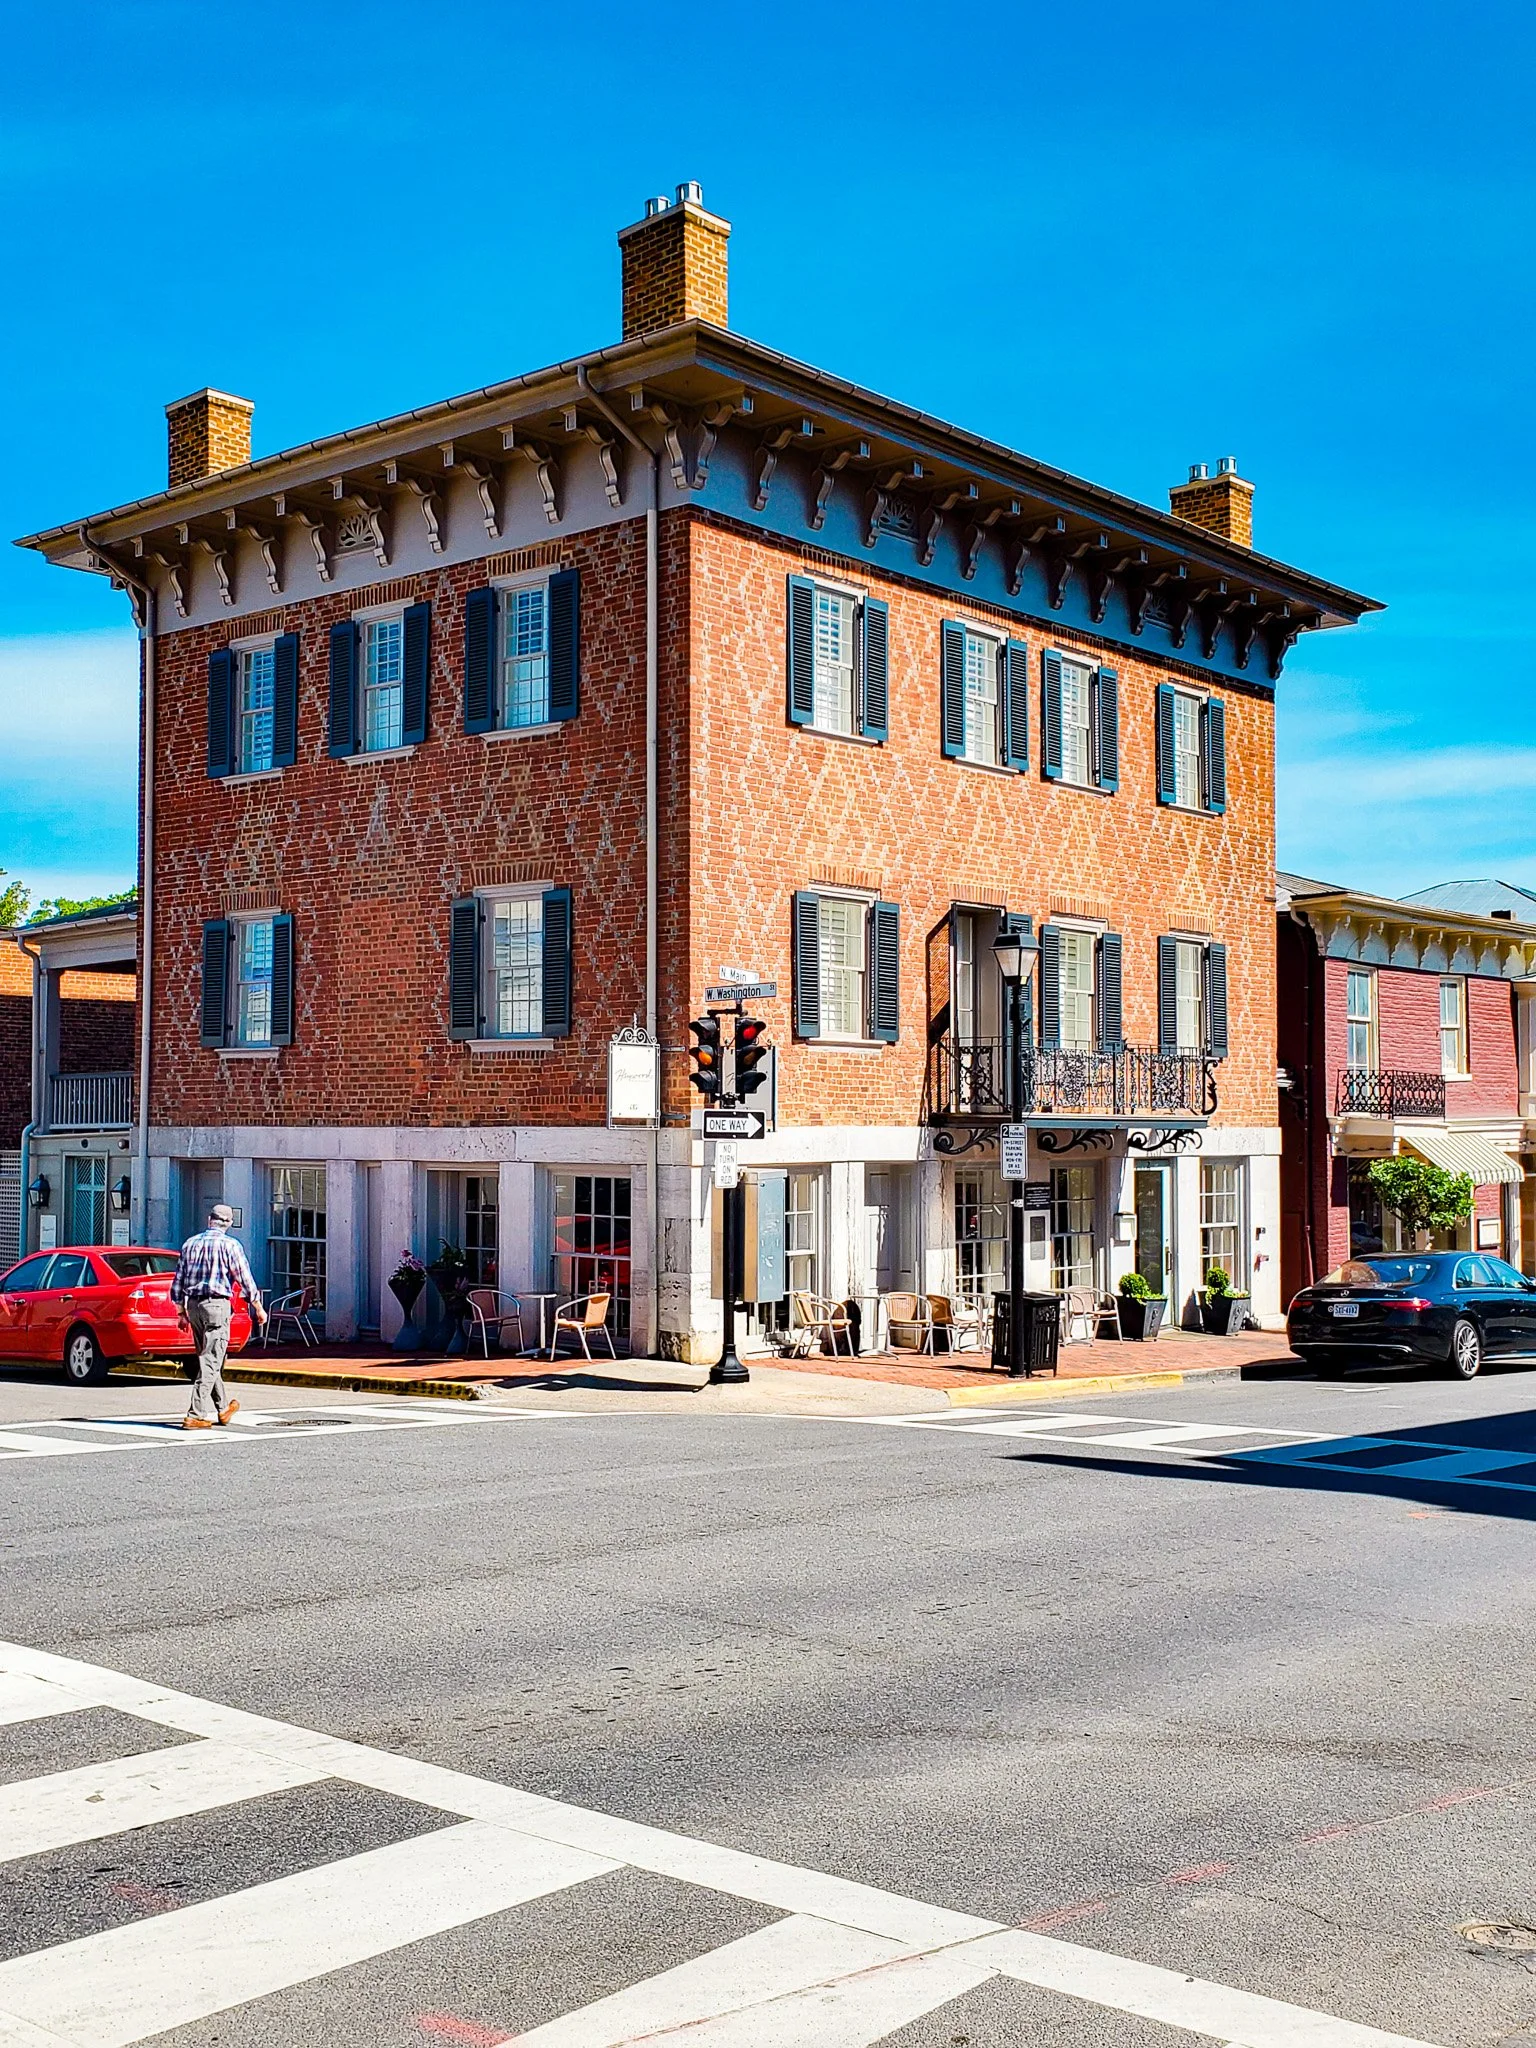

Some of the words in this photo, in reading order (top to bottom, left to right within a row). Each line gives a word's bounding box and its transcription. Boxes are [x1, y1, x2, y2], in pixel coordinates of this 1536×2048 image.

[721, 967, 726, 978] N
[730, 969, 747, 982] Main
[706, 989, 715, 1000] W.
[717, 986, 761, 999] Washington
[709, 1119, 726, 1131] ONE
[729, 1119, 747, 1131] WAY
[1002, 1126, 1009, 1137] 2
[723, 1144, 732, 1153] NO
[720, 1155, 735, 1164] TURN
[723, 1165, 731, 1174] ON
[720, 1175, 732, 1184] RED
